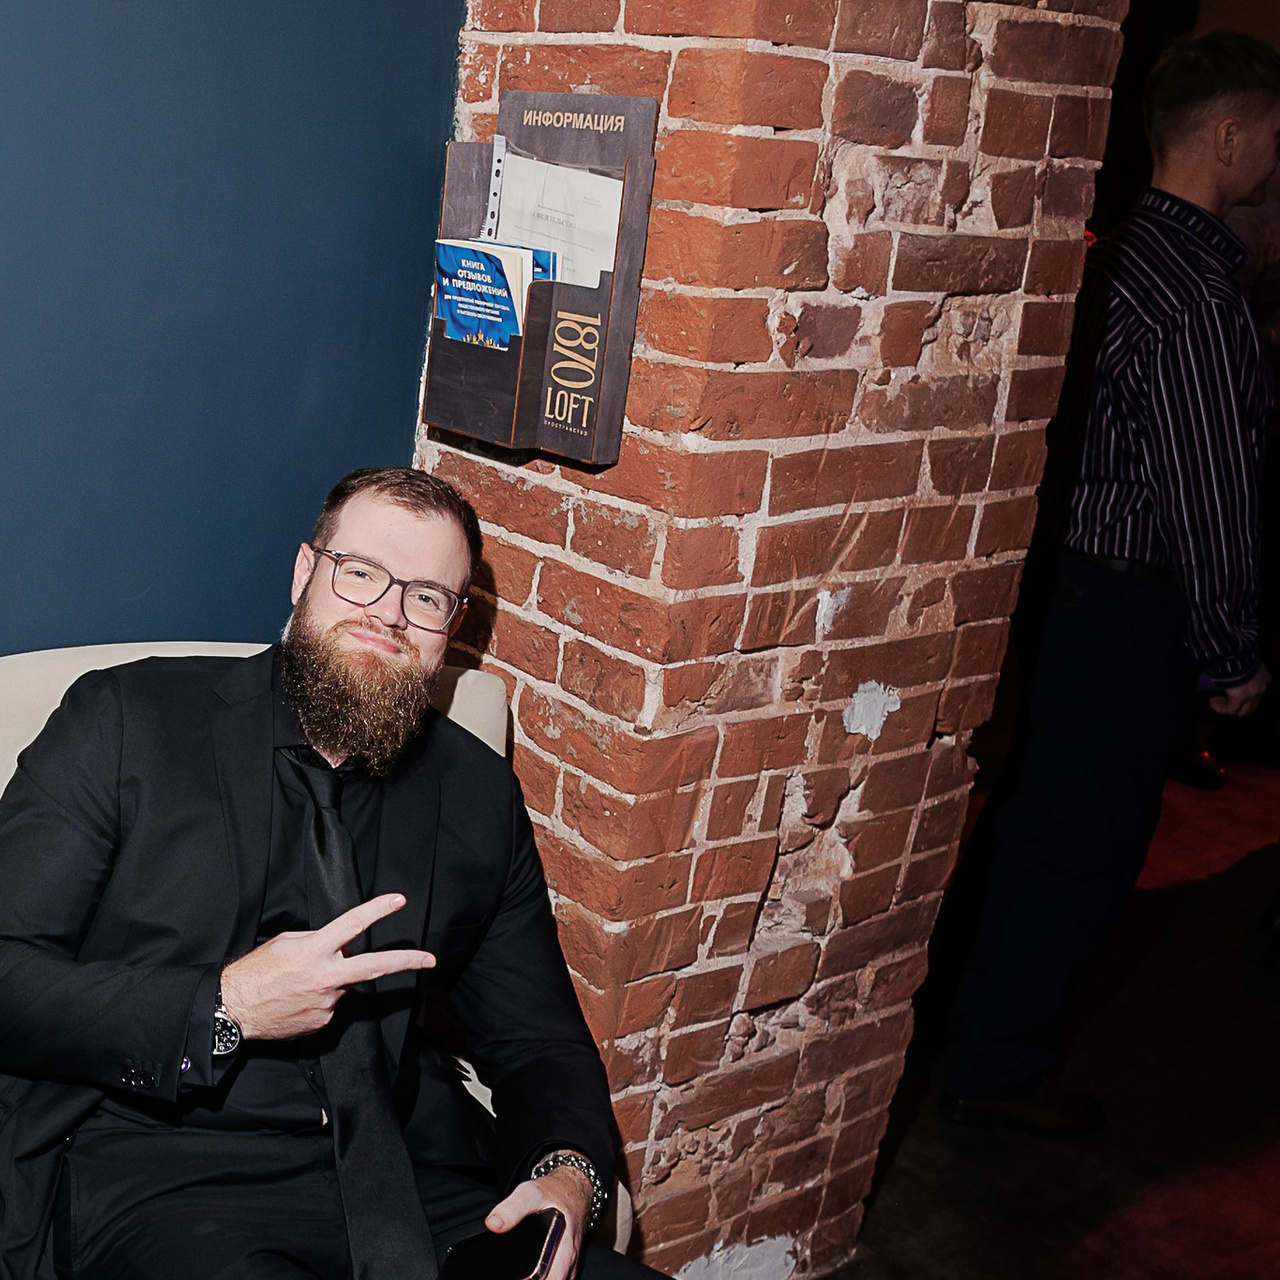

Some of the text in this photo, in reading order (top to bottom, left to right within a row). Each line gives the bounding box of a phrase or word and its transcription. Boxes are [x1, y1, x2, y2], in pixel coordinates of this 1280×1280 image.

[523, 109, 625, 134] ИНФОРМАЦИЯ
[457, 268, 493, 284] ОТЗЫВОВ
[461, 258, 486, 272] КНИГА
[442, 277, 509, 299] И ПРЕДЛОЖЕНИЙ
[551, 310, 602, 389] 1870
[544, 387, 595, 428] LOFT
